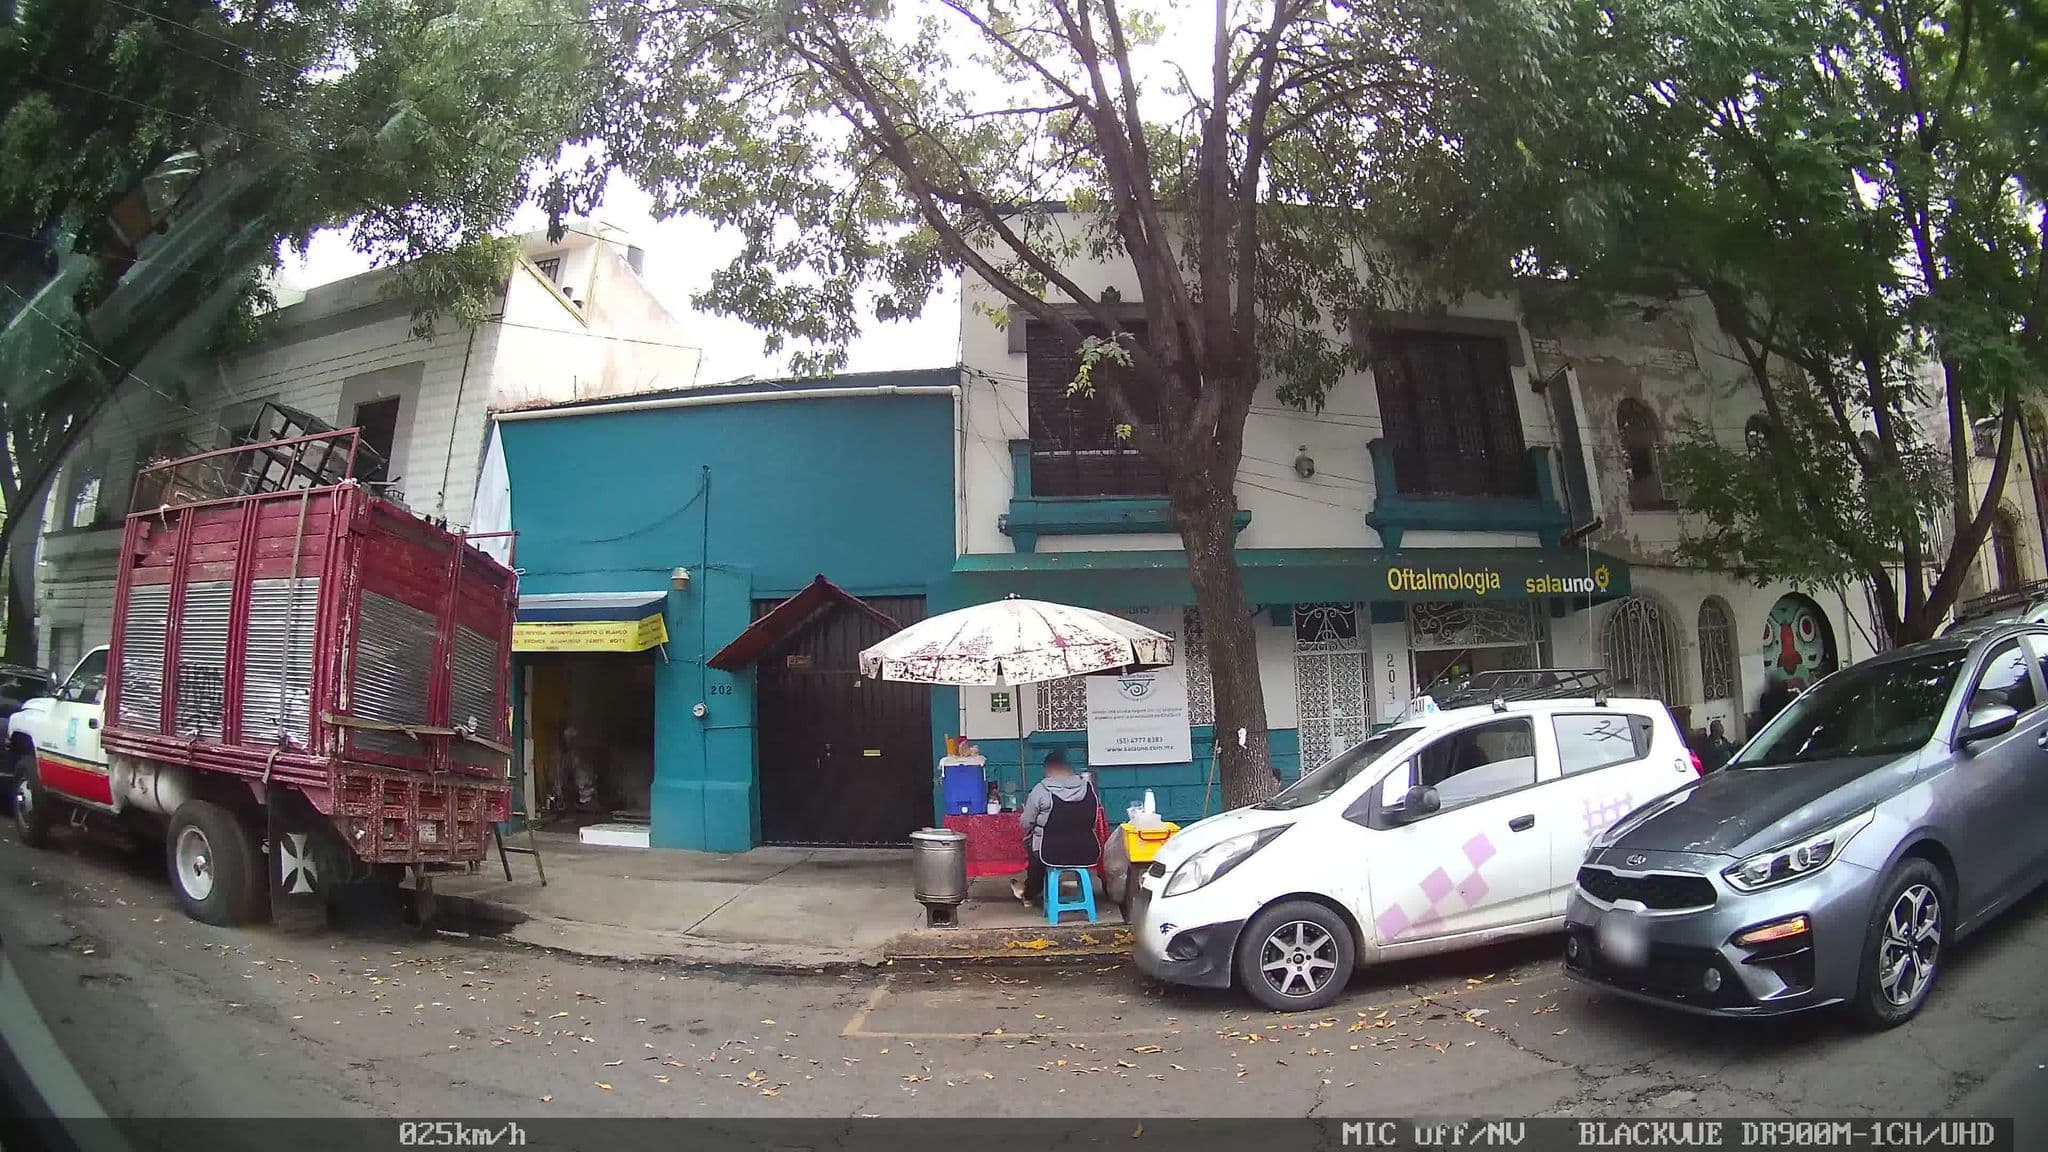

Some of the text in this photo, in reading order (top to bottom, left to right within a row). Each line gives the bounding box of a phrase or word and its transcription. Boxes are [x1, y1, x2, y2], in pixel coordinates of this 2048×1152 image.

[1387, 567, 1500, 595] Oftalmologia
[1526, 573, 1594, 593] salauno
[710, 685, 733, 695] 202
